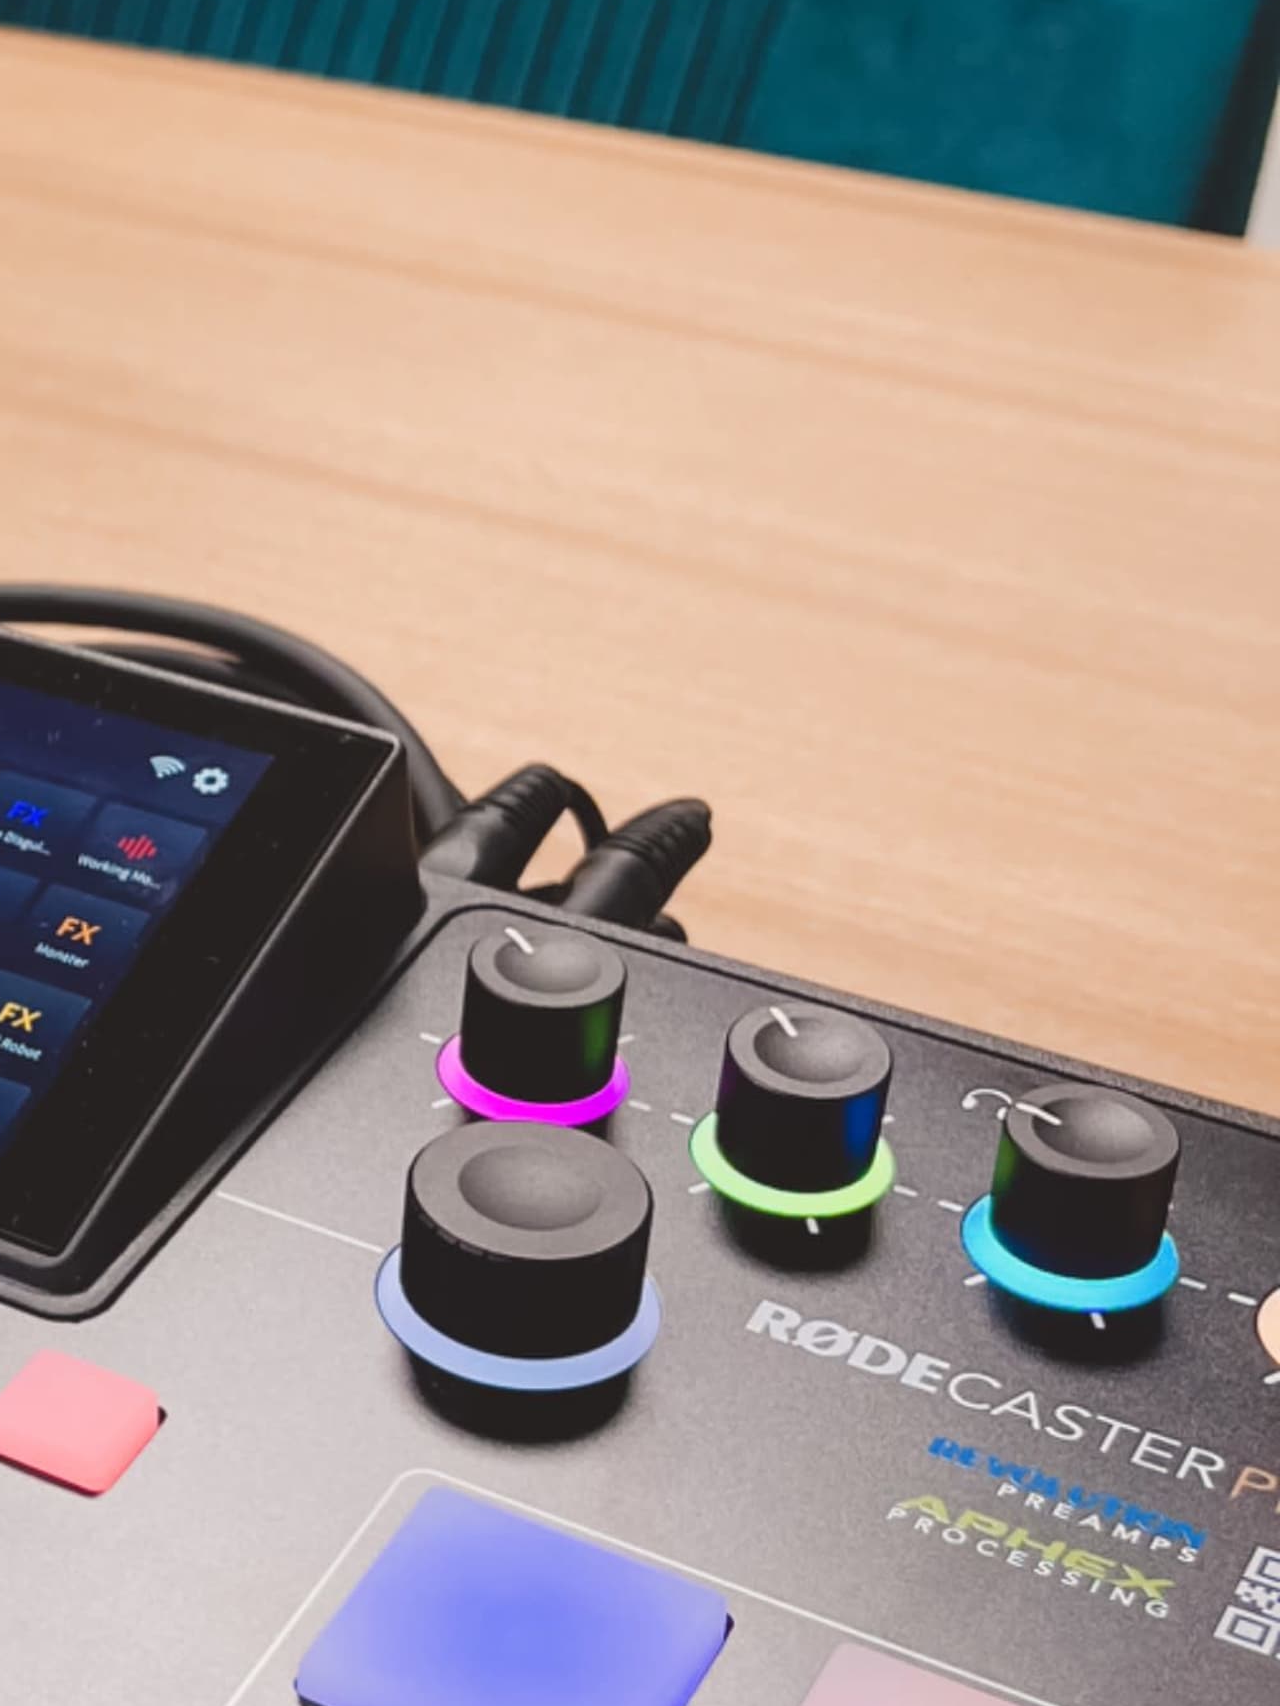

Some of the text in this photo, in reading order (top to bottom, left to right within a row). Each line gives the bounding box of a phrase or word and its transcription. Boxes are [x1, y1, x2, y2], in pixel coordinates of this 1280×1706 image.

[6, 799, 49, 828] FX
[55, 915, 102, 946] FX
[0, 1037, 42, 1062] Robot
[898, 1493, 1177, 1600] APHEX
[996, 1481, 1199, 1564] PREAMPS
[885, 1505, 1170, 1619] PROCESSING
